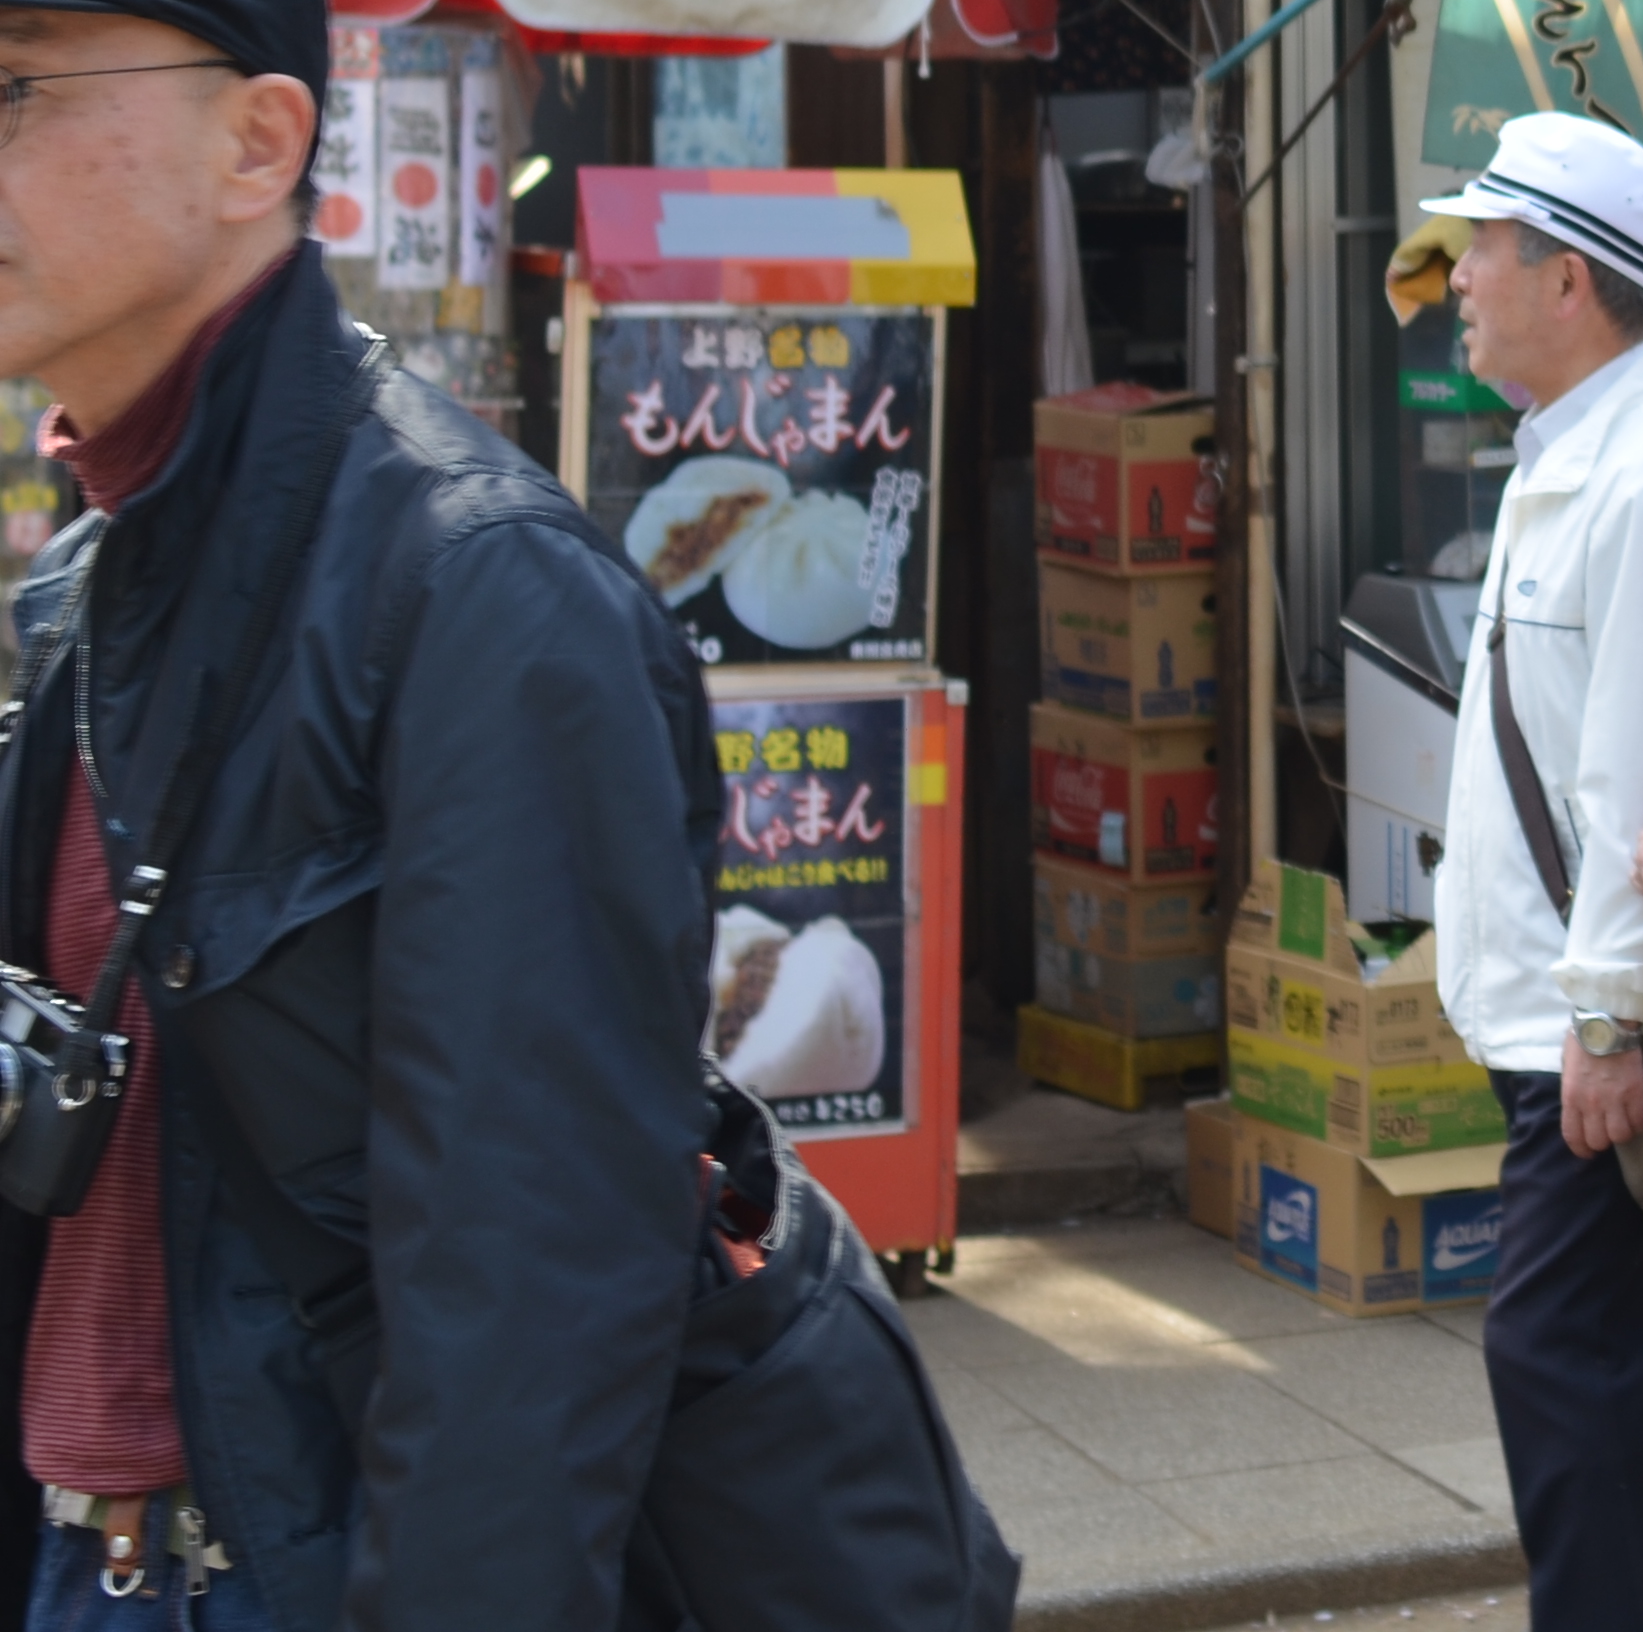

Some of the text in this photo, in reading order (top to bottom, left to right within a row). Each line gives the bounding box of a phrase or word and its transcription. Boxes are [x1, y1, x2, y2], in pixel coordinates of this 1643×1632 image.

[683, 324, 850, 369] 上野名物
[620, 373, 912, 467] もんじゃまん
[714, 725, 849, 773] 野名物
[719, 773, 887, 862] じゃまん
